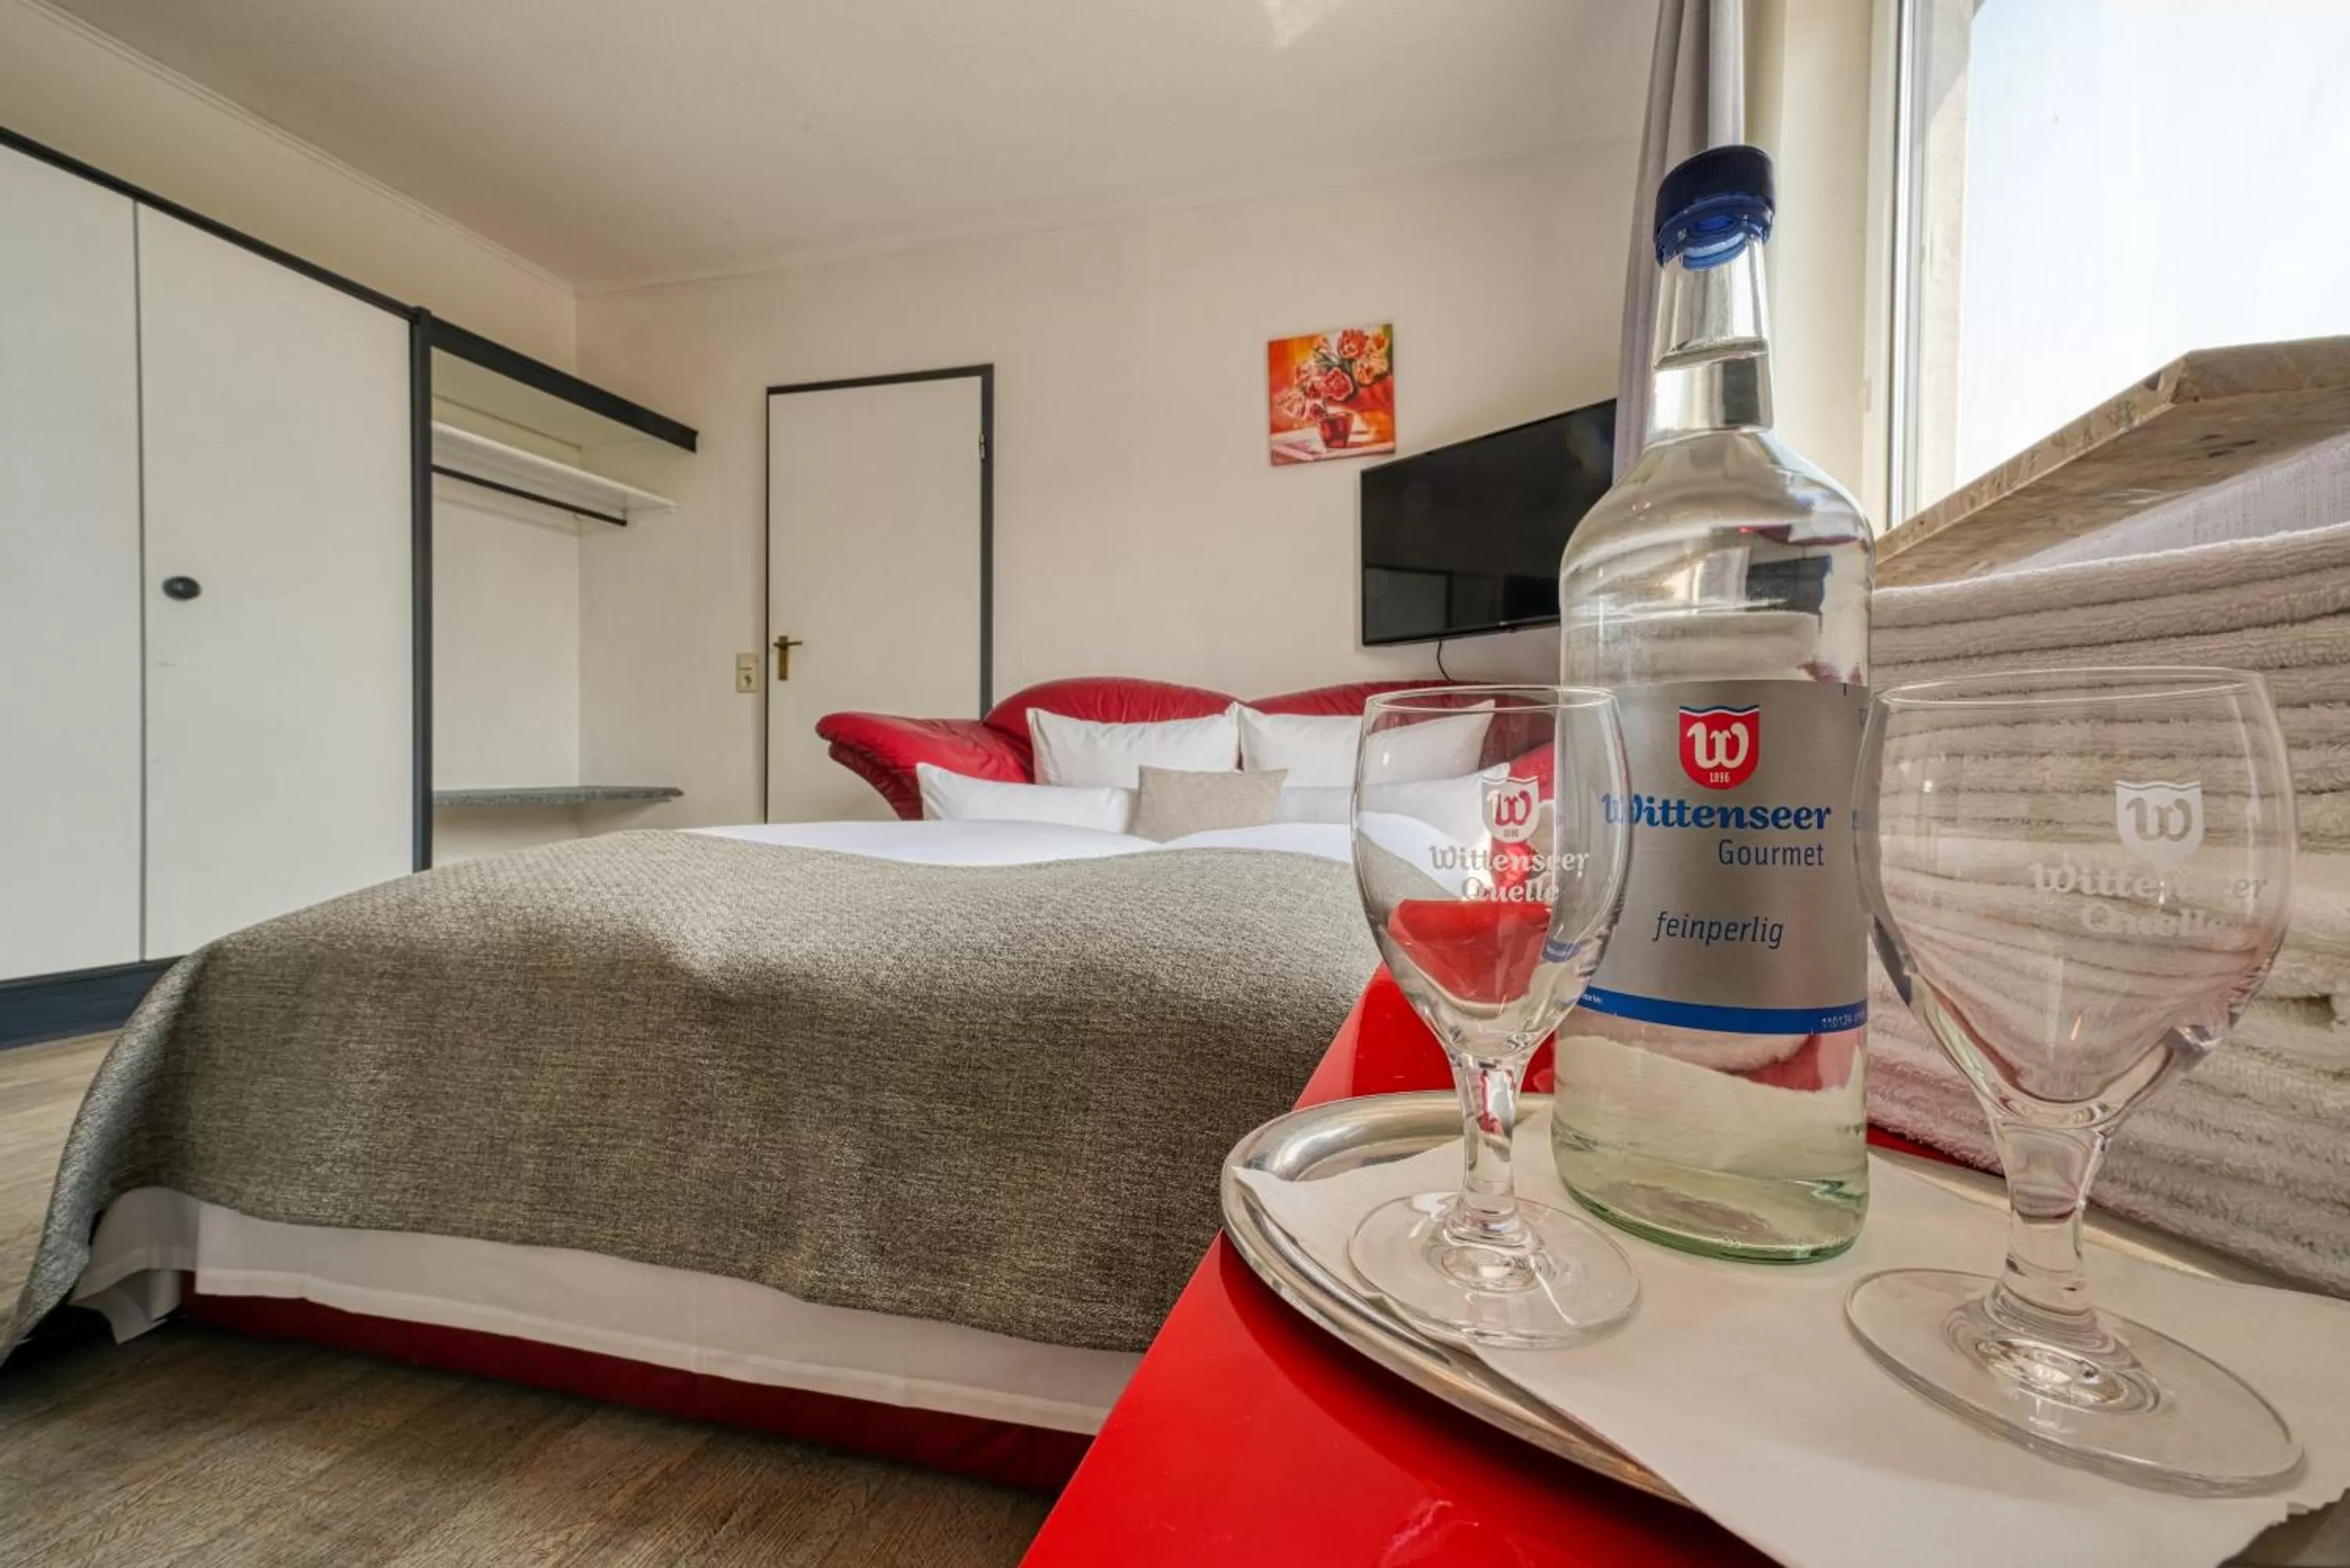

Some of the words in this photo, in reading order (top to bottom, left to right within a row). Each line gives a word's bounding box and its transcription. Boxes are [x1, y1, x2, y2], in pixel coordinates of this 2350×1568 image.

[1718, 839, 1825, 867] Gourmet
[1462, 876, 1560, 902] Quelle
[1652, 911, 1784, 949] feinperlig
